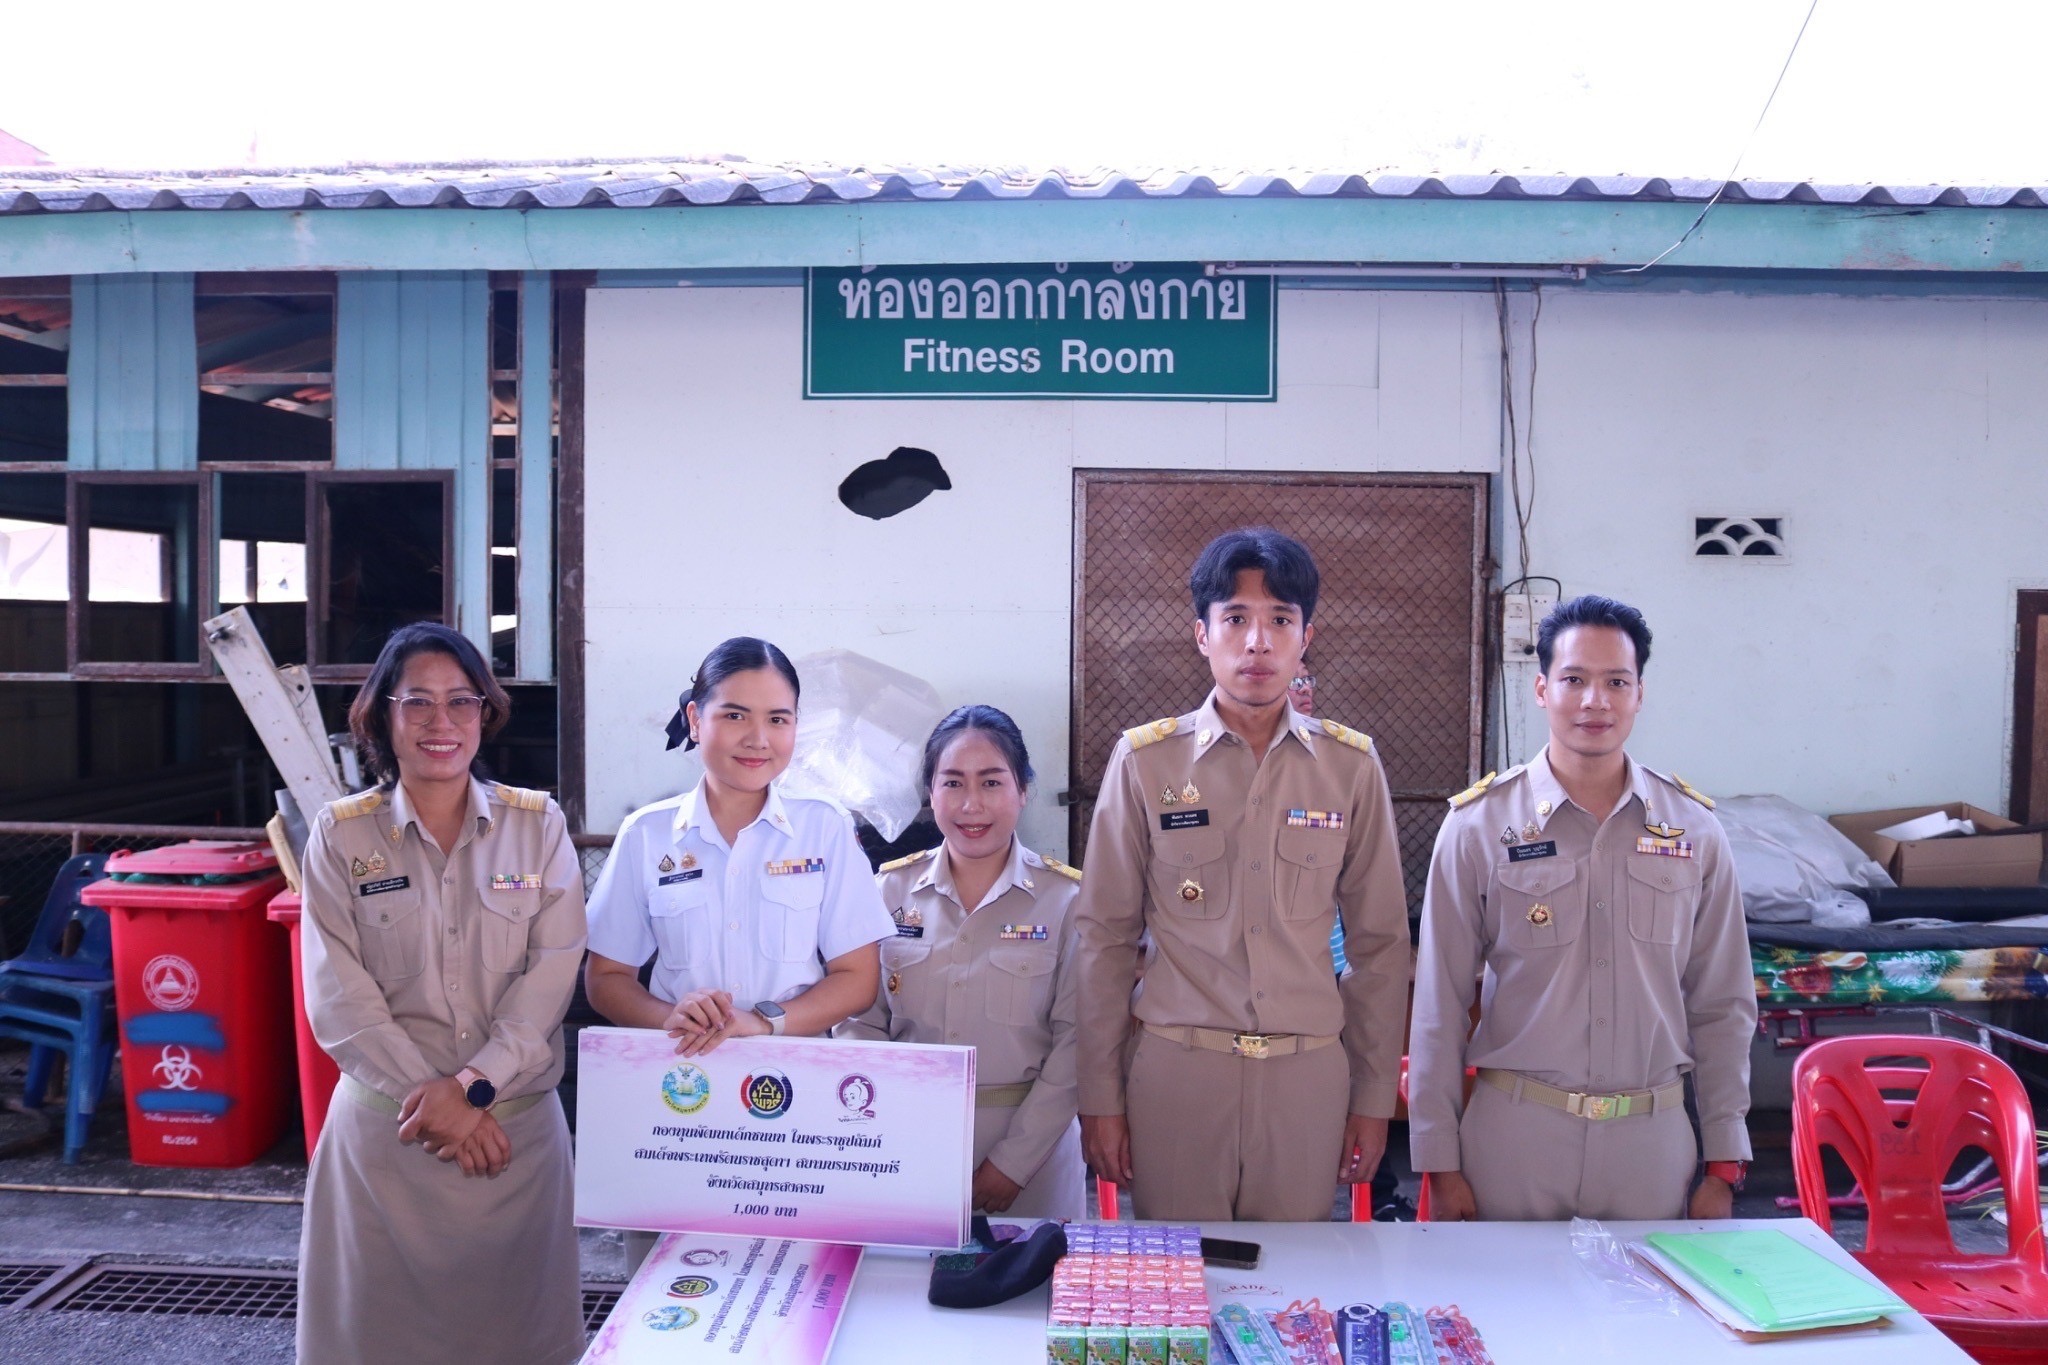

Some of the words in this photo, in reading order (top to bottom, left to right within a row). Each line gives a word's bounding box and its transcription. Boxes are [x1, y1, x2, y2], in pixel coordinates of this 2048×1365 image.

[903, 338, 1041, 374] Fitness
[1061, 338, 1174, 374] Room
[652, 1124, 786, 1143] กองทุนพัฒนาเด็กชนบท
[791, 1129, 883, 1151] ในพระราชูปถัมภ์
[634, 1146, 790, 1172] สมเด็จพระเทพรัตนราชสุดาฯ
[796, 1157, 900, 1178] สยามบรมราชกุมารี
[707, 1174, 825, 1195] จังหวัดสมุทรสงคราม
[733, 1203, 769, 1216] 1,000
[774, 1206, 798, 1218] บาท
[812, 1288, 831, 1310] 1,000
